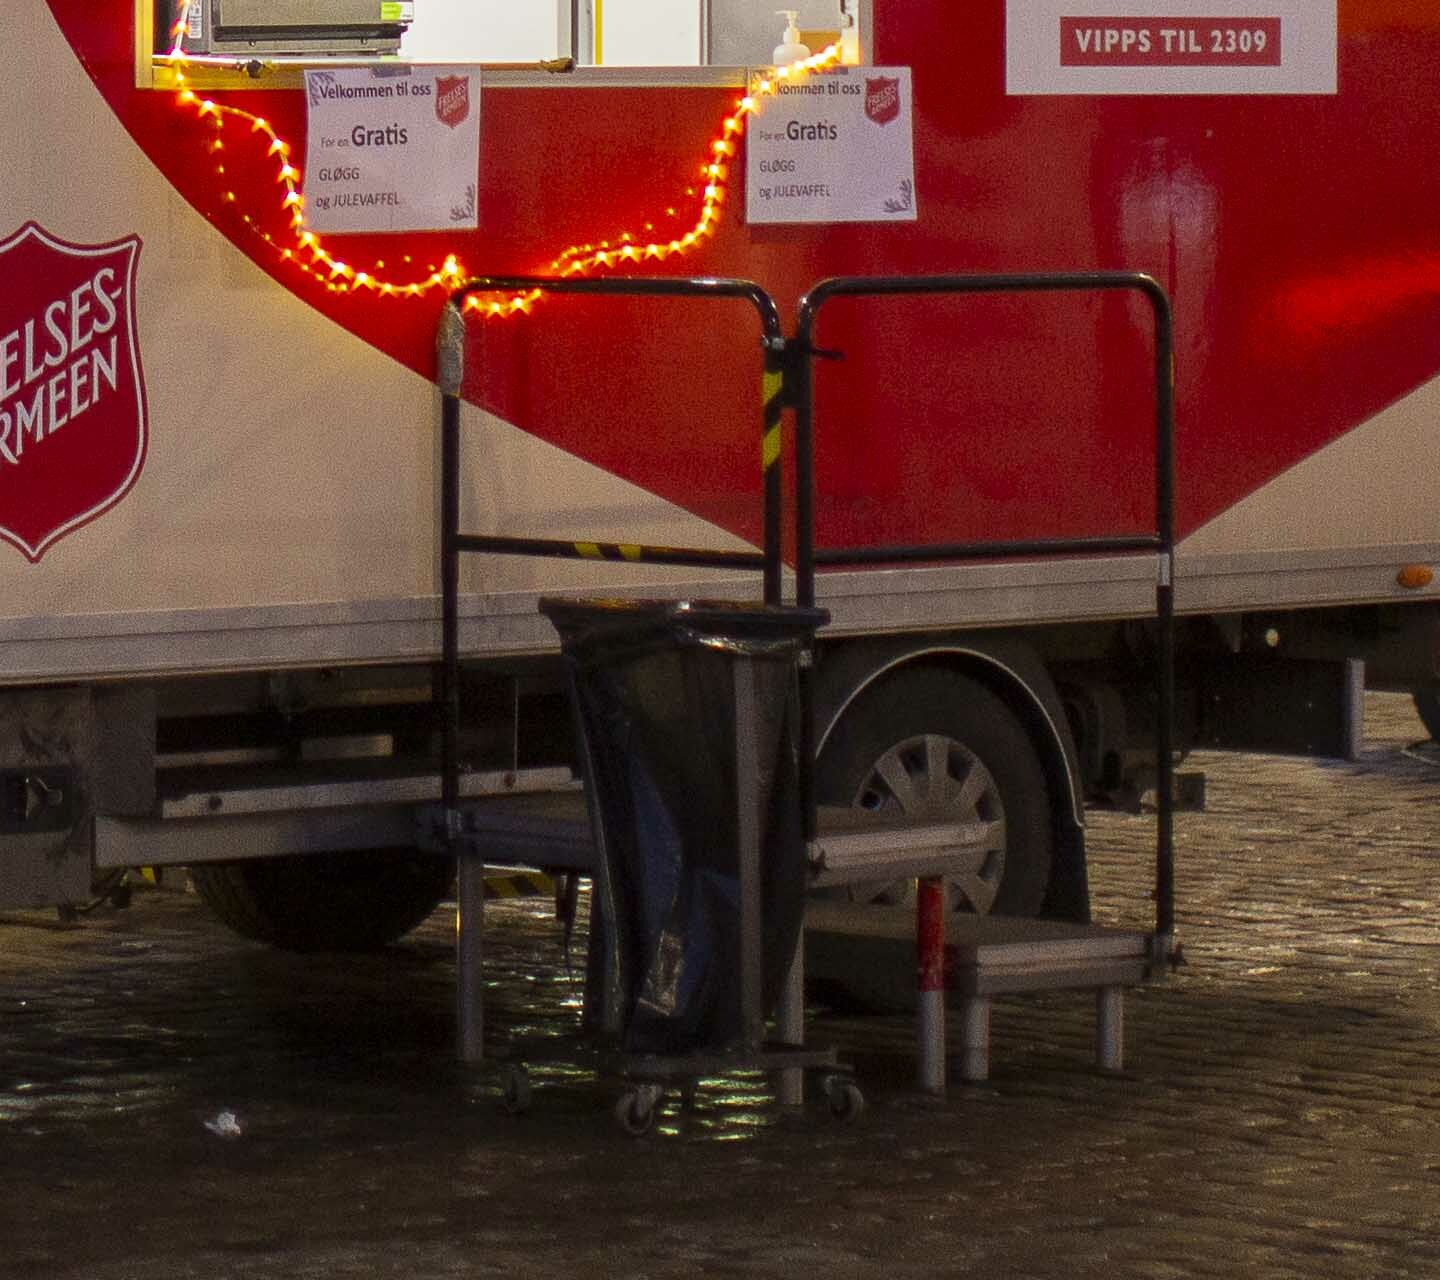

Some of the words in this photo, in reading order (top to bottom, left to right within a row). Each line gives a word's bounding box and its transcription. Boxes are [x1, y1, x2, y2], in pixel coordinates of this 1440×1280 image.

[1075, 28, 1152, 53] VIPPS
[1160, 28, 1202, 53] TIL
[1210, 29, 1267, 53] 2309
[320, 83, 393, 100] Velkommen
[396, 82, 408, 96] til
[411, 84, 432, 96] oss
[828, 82, 839, 95] til
[842, 83, 861, 95] oss
[351, 122, 408, 147] Gratis
[786, 120, 838, 141] Gratis
[318, 167, 360, 182] GLØGG
[759, 159, 796, 173] GLØGG
[316, 196, 330, 210] og
[332, 191, 400, 208] JULEVAFFEL
[759, 186, 772, 200] og
[773, 183, 831, 198] JULEVAFFEL
